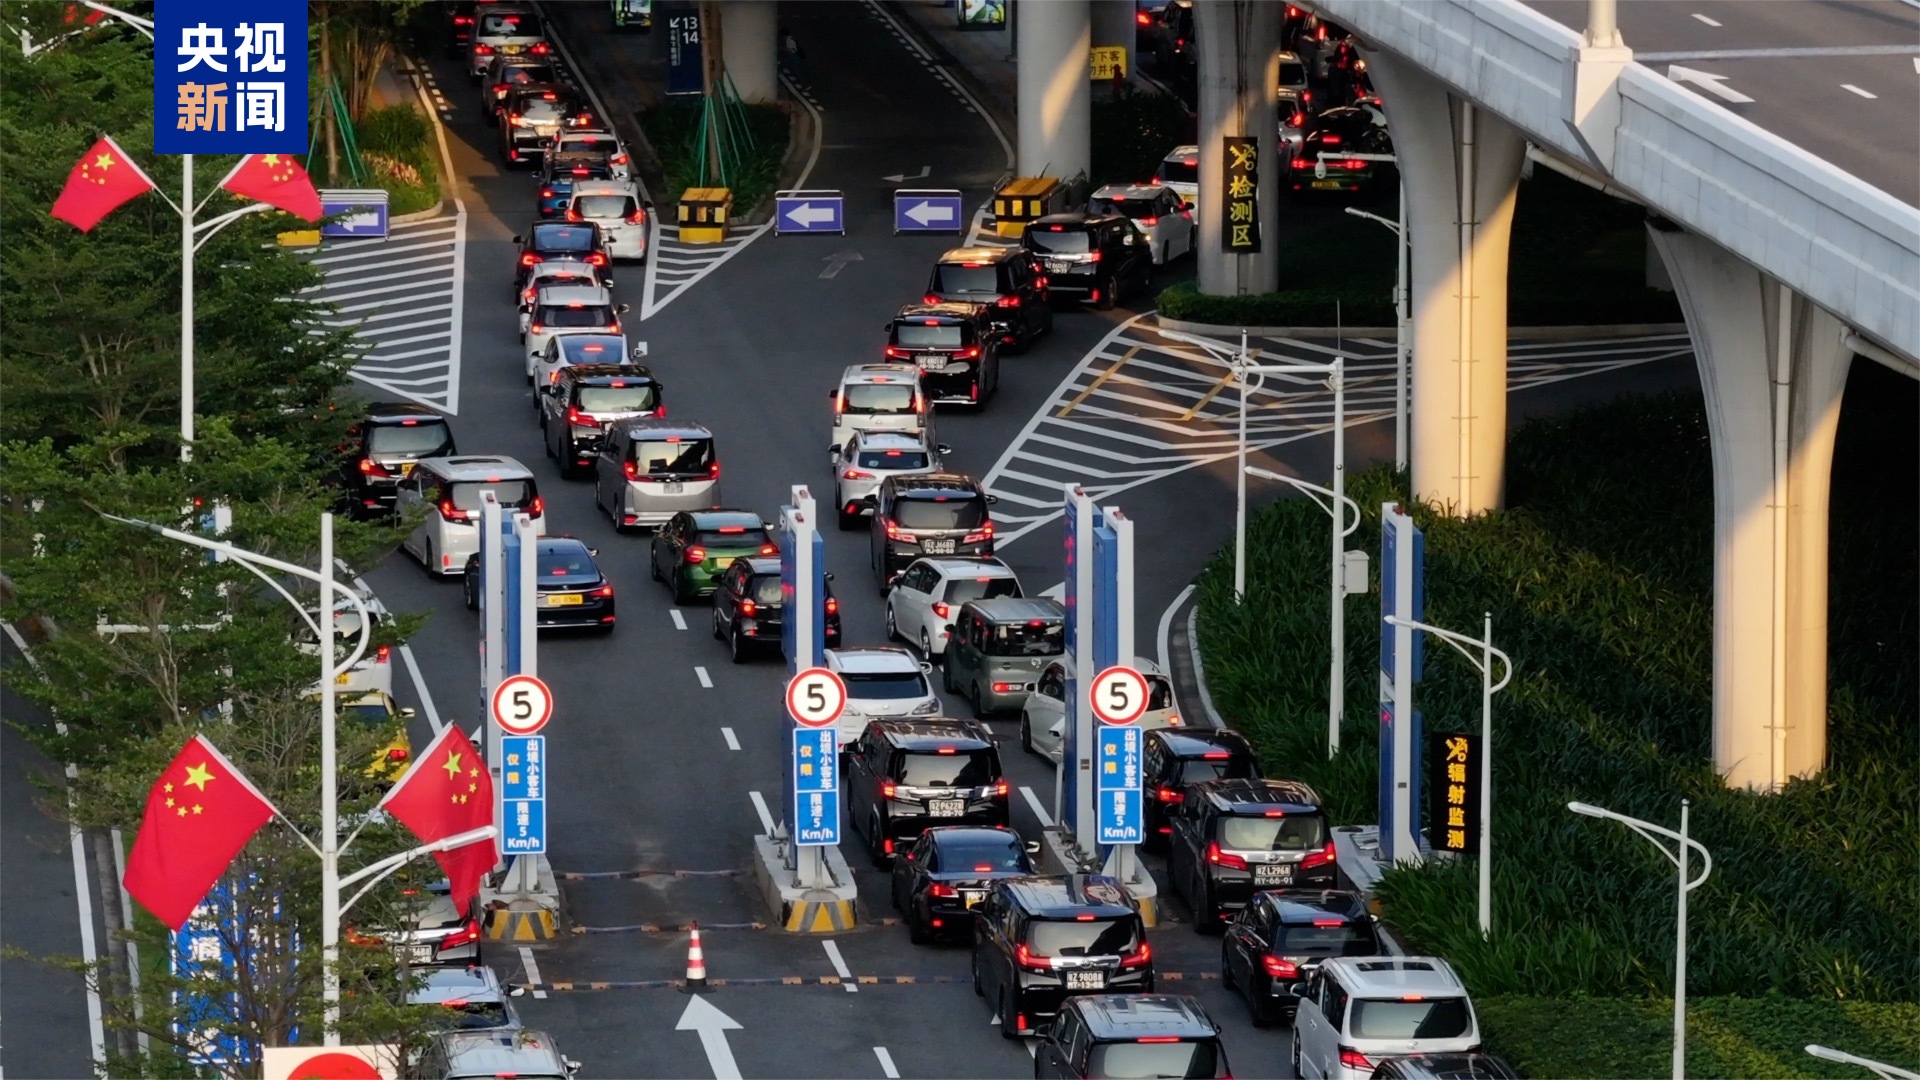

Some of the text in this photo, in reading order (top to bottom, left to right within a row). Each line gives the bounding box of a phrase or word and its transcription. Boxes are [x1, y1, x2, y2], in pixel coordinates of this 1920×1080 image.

[682, 16, 698, 30] 13
[682, 31, 699, 45] 14
[1228, 174, 1256, 247] 检测区
[512, 690, 532, 720] 5
[807, 683, 826, 713] 5
[1110, 682, 1129, 712] 5
[506, 753, 520, 785] 仅限
[526, 739, 540, 799] 出境小客车
[799, 744, 813, 777] 仅限
[819, 730, 833, 790] 出境小客车
[1104, 742, 1118, 774] 仅限
[1124, 729, 1137, 789] 出境小客车
[1446, 762, 1467, 850] 辐射监测
[507, 837, 540, 850] Km/h
[801, 829, 834, 842] Km/h
[1104, 826, 1137, 840] Km/h
